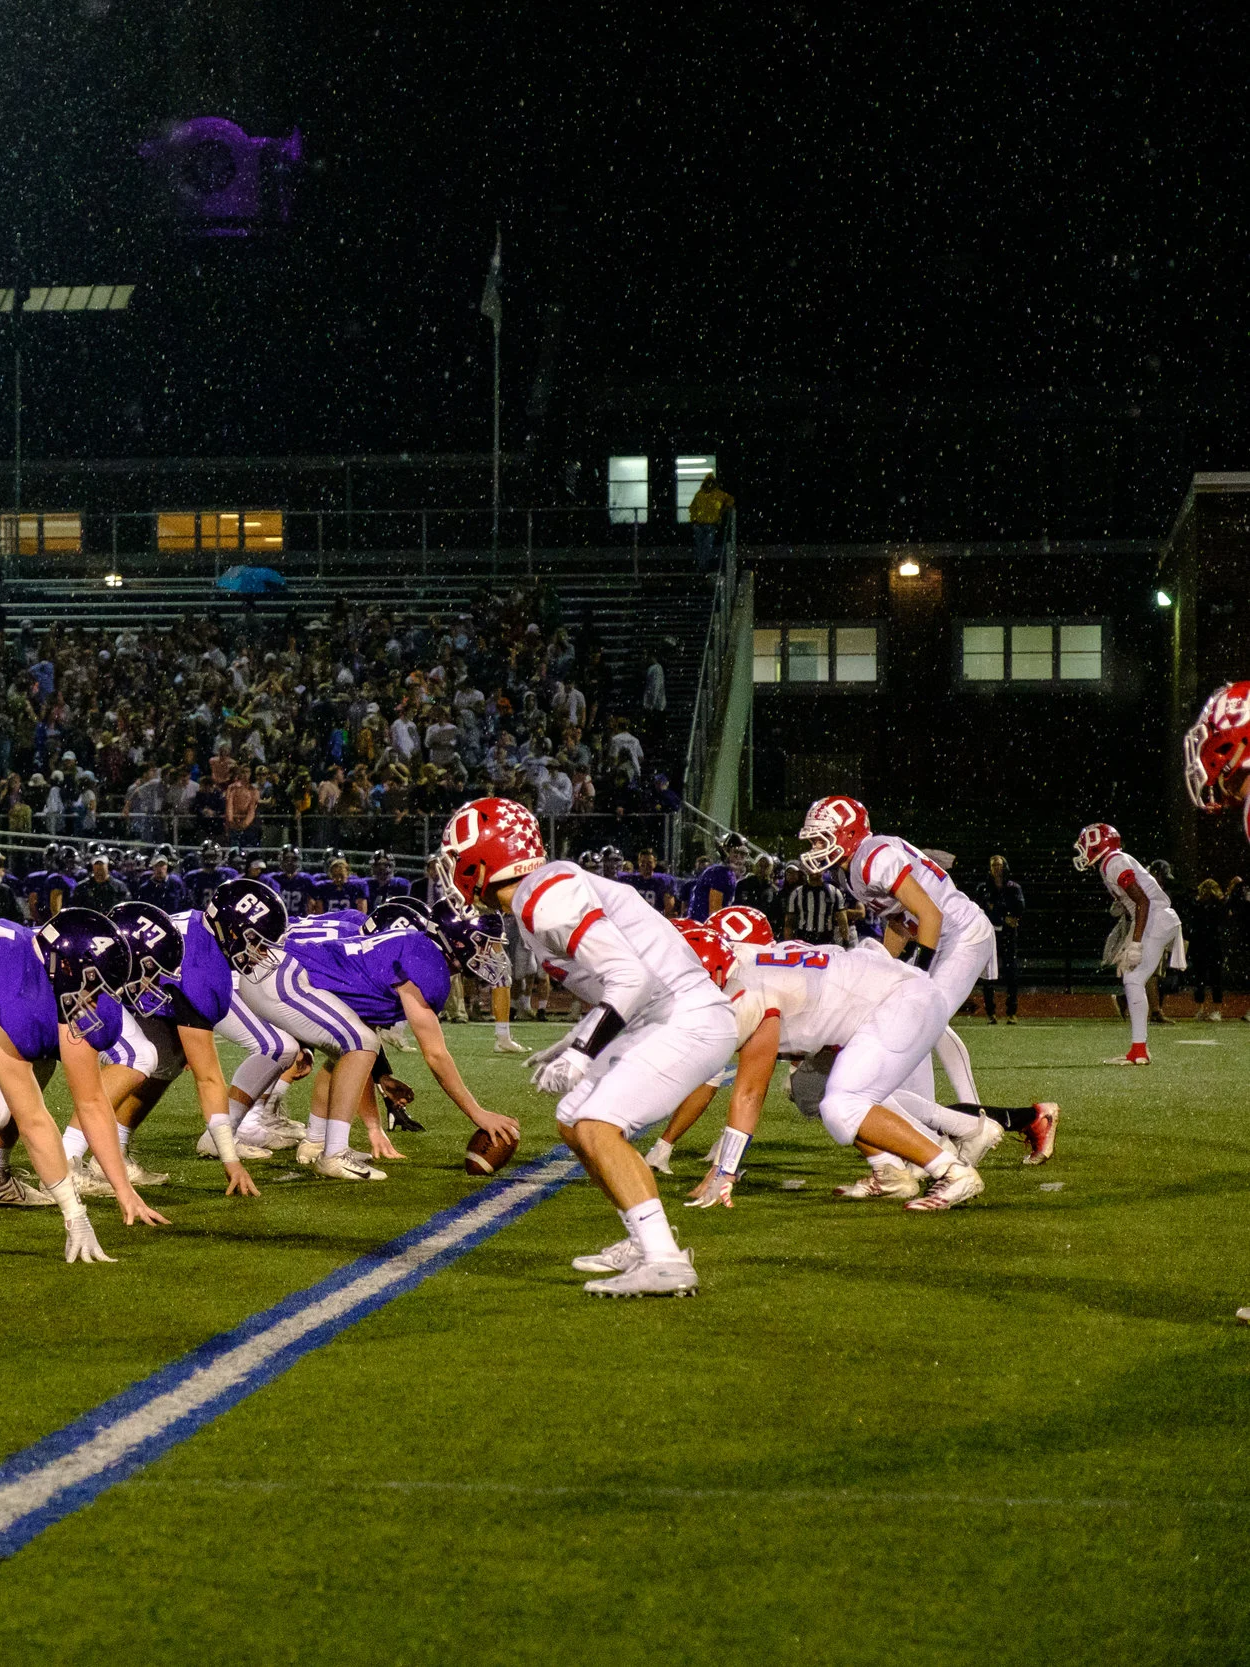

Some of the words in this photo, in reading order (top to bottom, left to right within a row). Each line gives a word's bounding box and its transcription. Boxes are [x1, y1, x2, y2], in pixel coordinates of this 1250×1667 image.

[235, 893, 270, 924] 67
[91, 936, 116, 957] 4
[132, 915, 167, 950] 77
